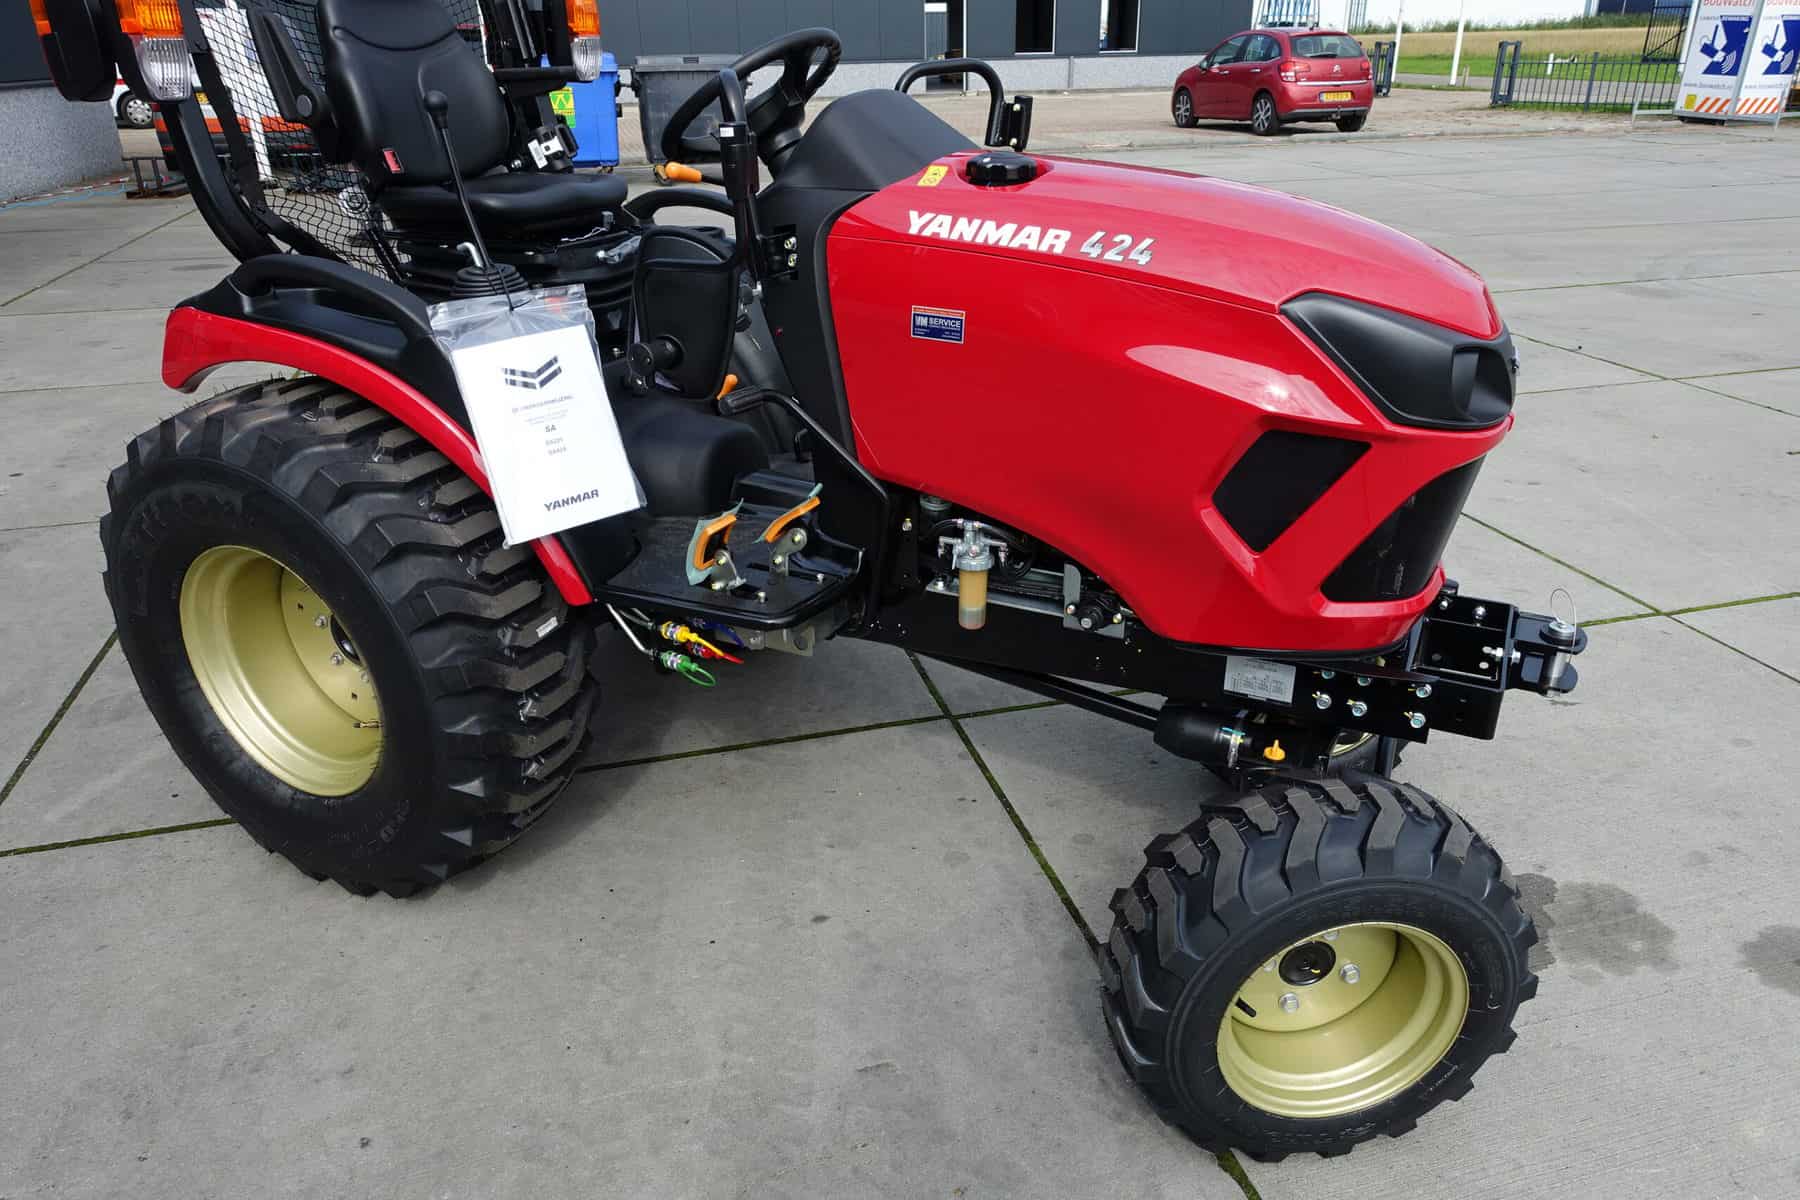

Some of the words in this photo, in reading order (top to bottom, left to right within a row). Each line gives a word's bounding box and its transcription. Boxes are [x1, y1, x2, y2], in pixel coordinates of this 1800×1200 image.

[908, 210, 1072, 254] YANMAR
[1080, 231, 1154, 265] 424
[929, 316, 961, 328] SERVICE
[544, 489, 599, 511] YANMAR
